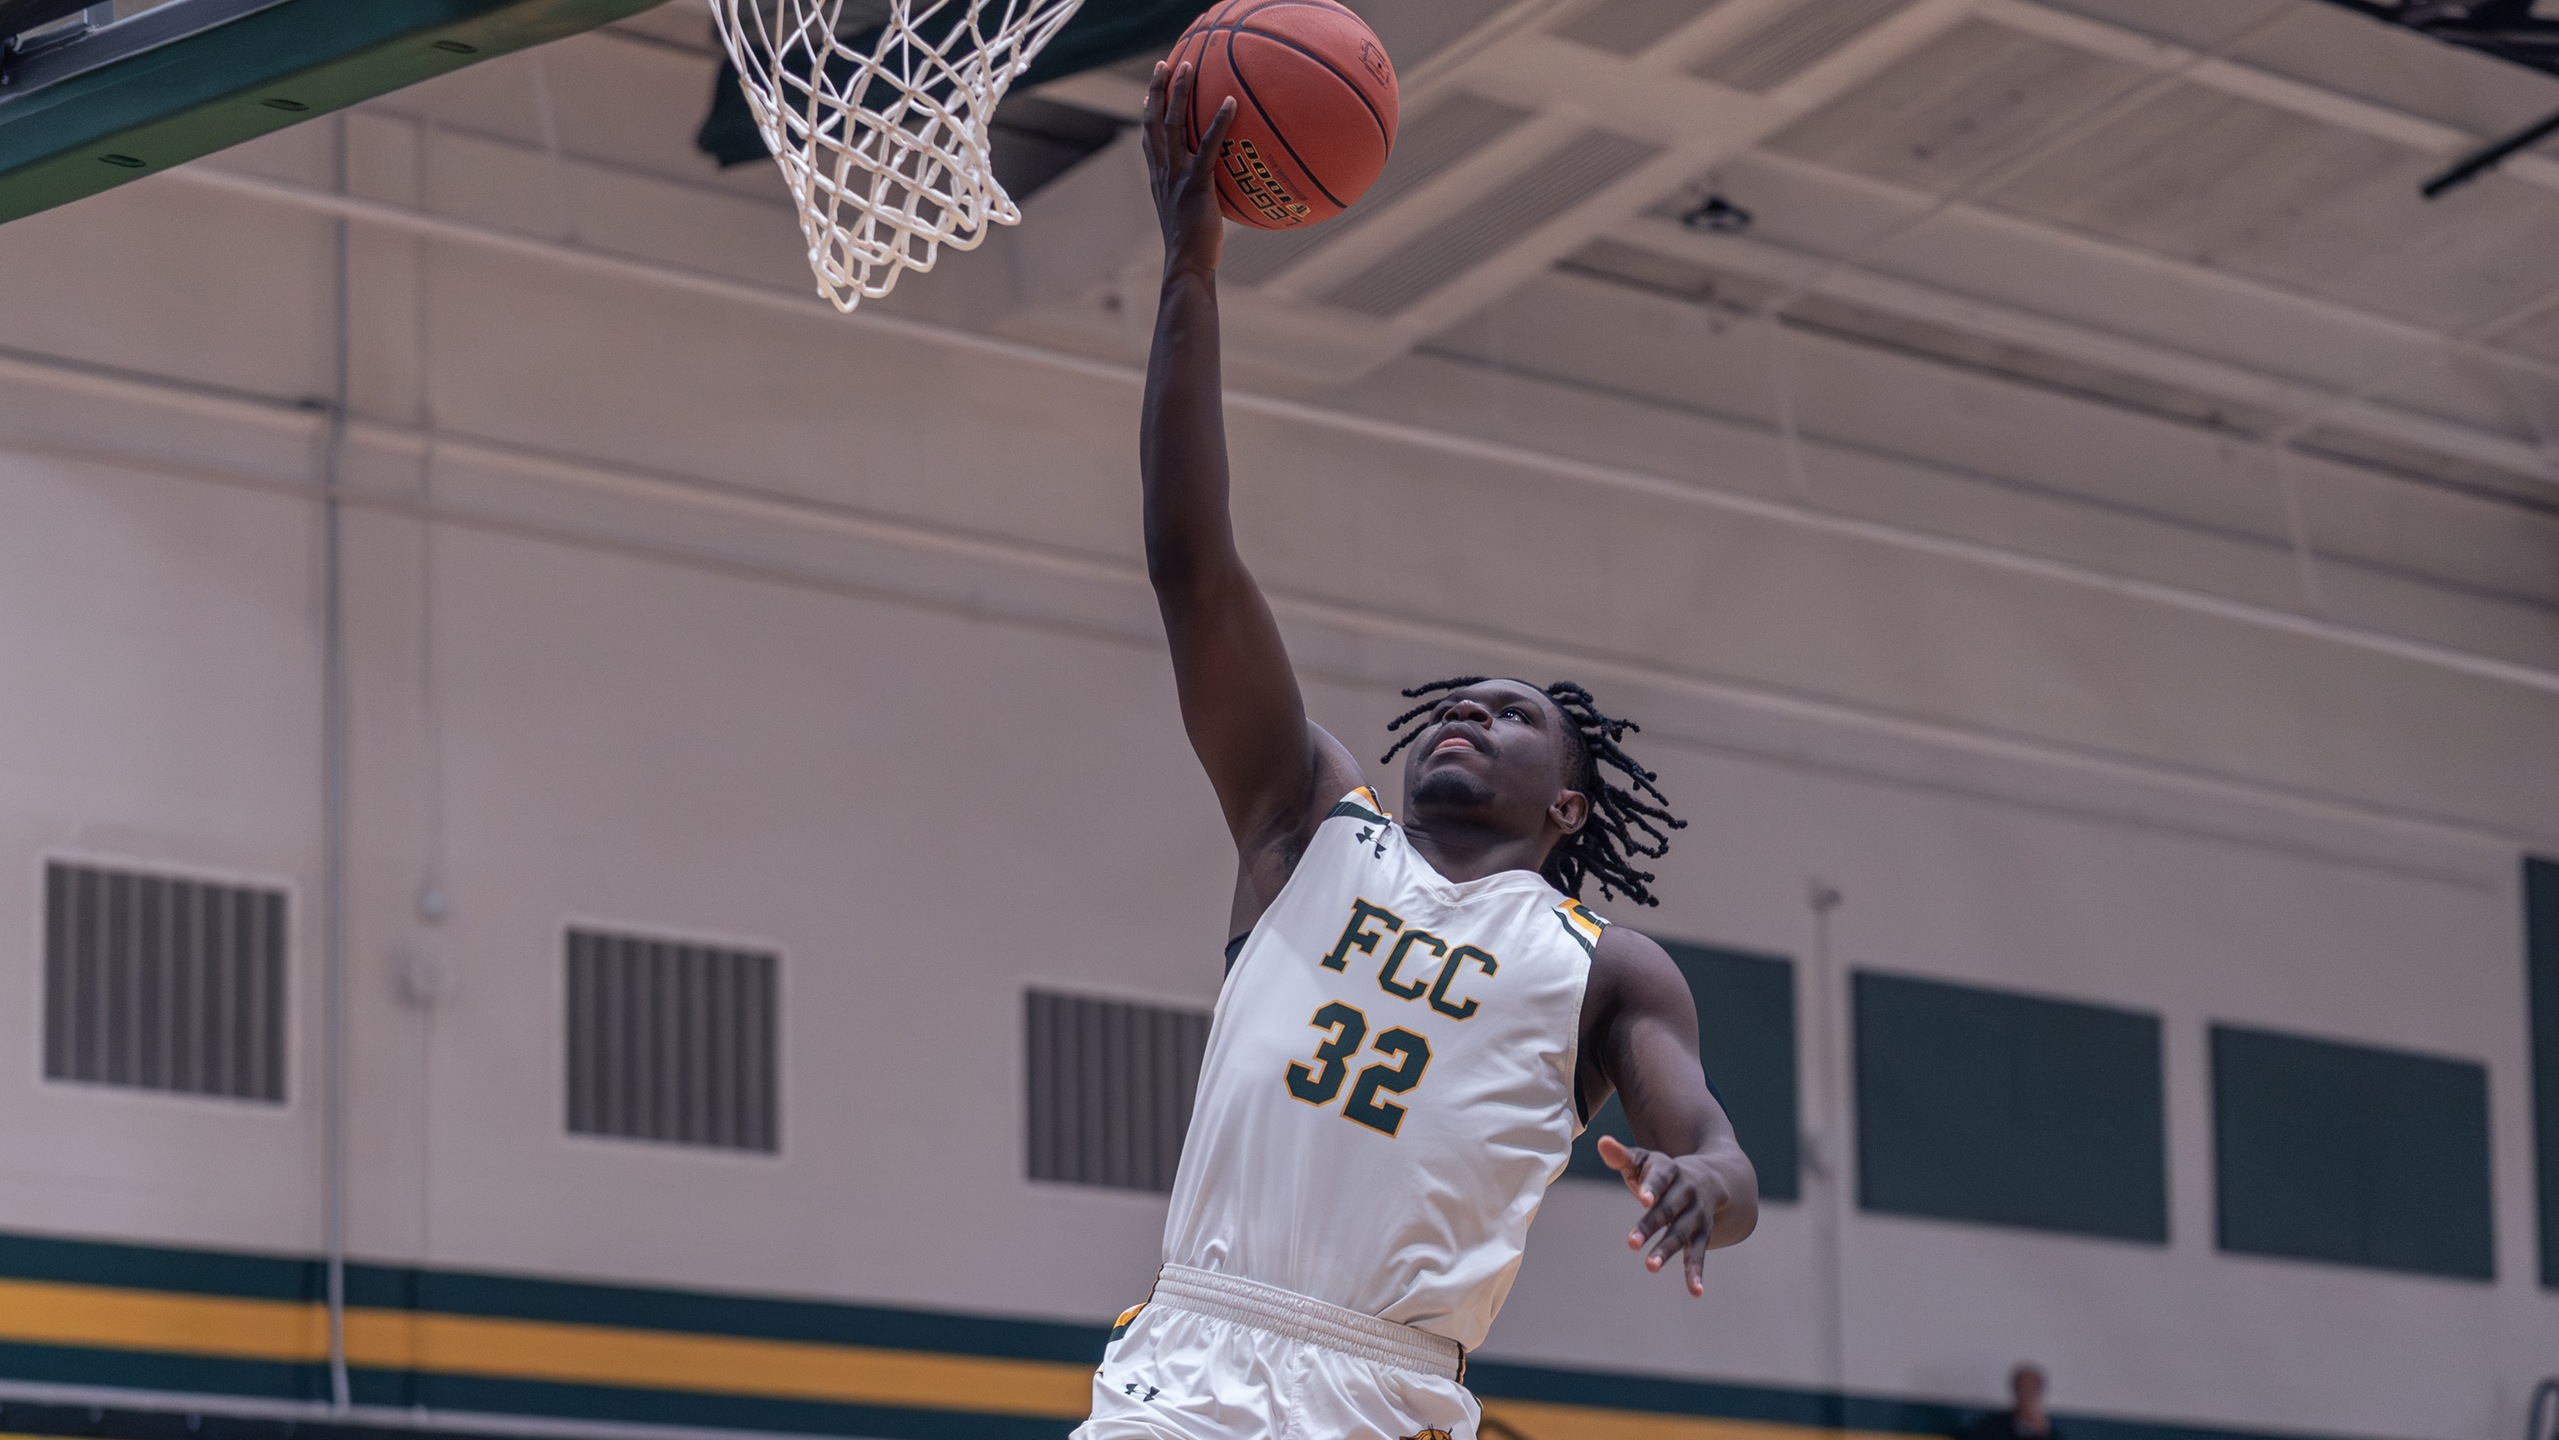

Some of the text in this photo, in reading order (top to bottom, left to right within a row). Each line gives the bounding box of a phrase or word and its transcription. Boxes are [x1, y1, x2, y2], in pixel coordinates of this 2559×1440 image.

[1220, 139, 1304, 227] LEGACY
[1320, 897, 1500, 1022] FCC
[1284, 1000, 1433, 1139] 32
